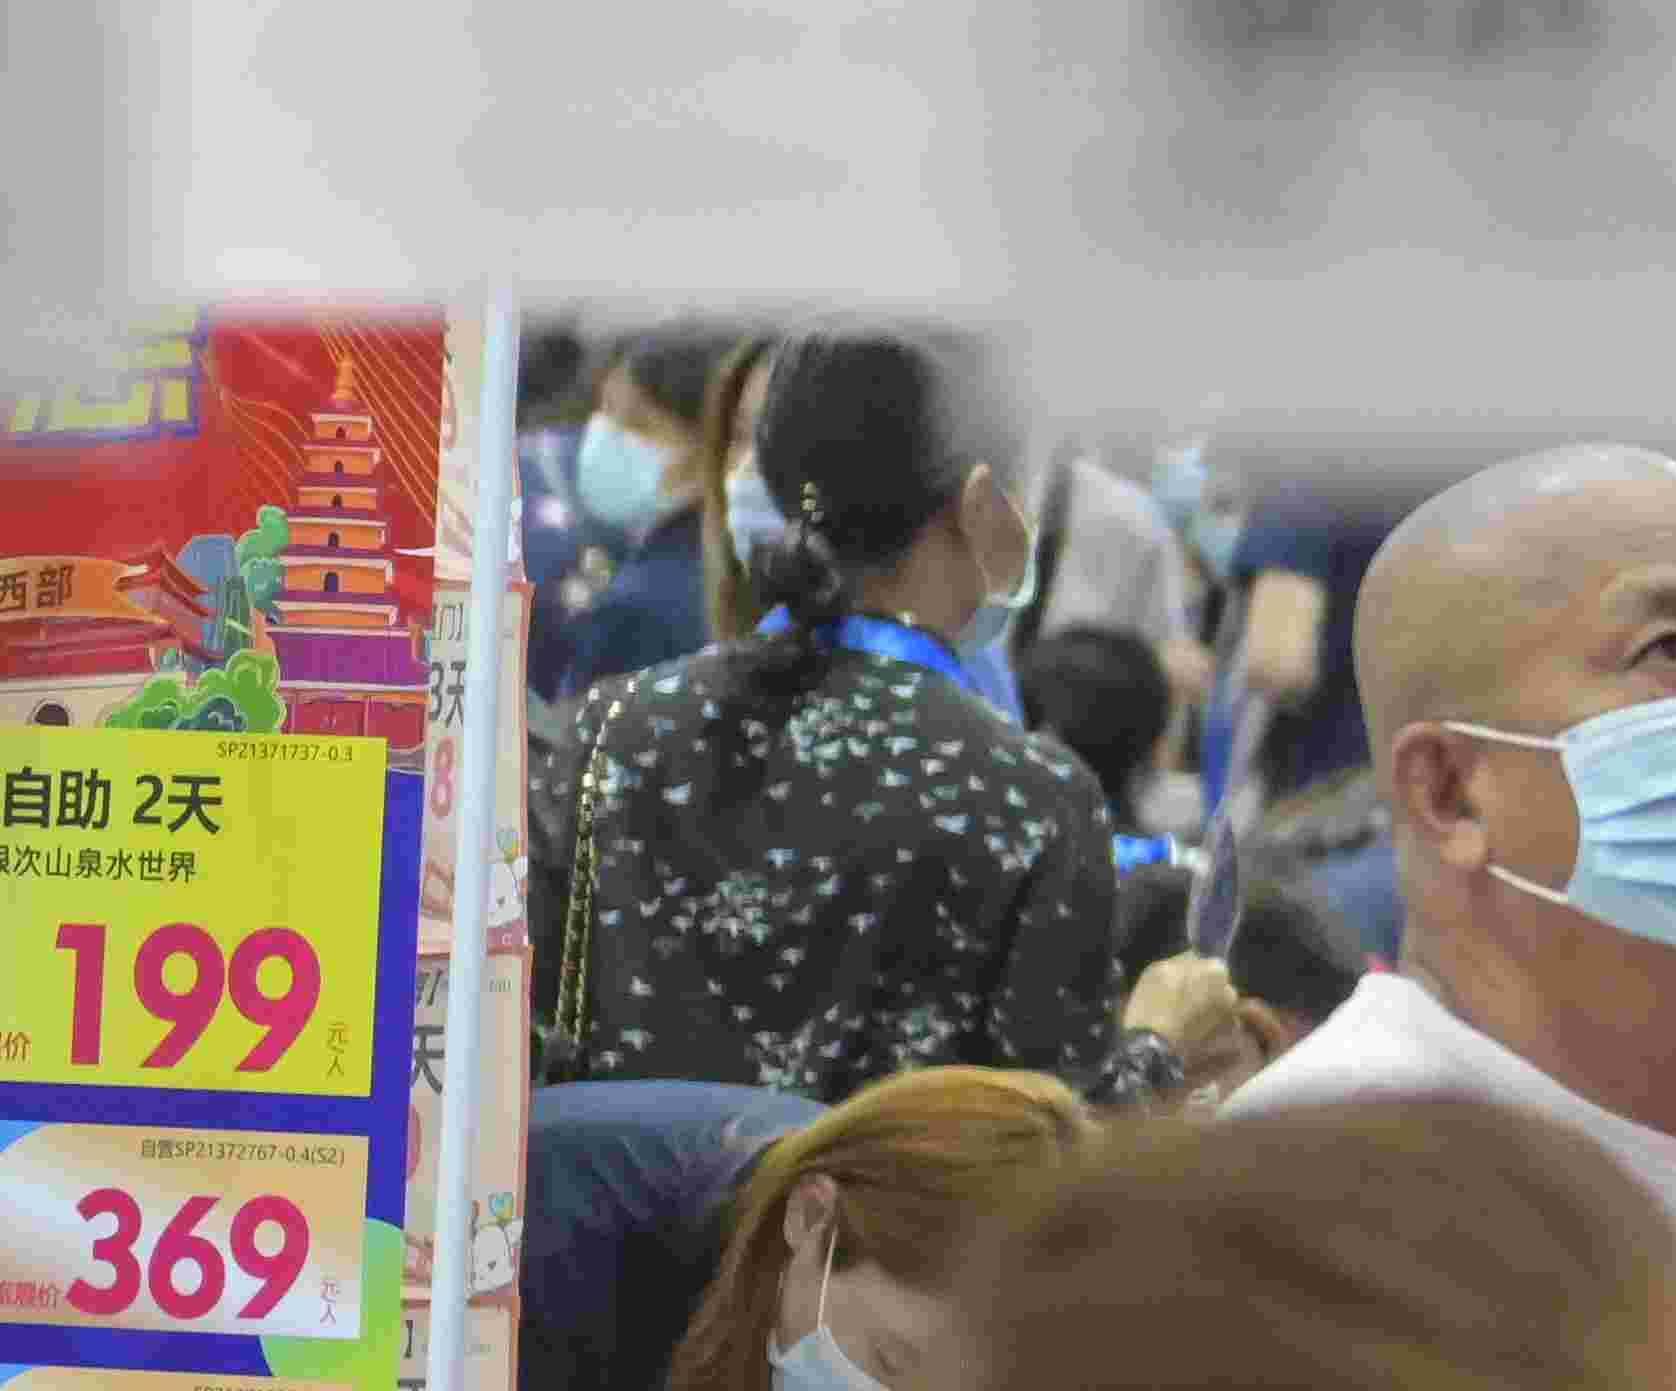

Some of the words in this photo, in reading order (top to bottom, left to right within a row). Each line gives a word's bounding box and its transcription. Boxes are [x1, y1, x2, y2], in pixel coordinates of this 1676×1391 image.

[4, 766, 111, 830] 自助
[133, 774, 223, 834] 2天
[55, 922, 322, 1073] 199
[66, 1187, 310, 1320] 369
